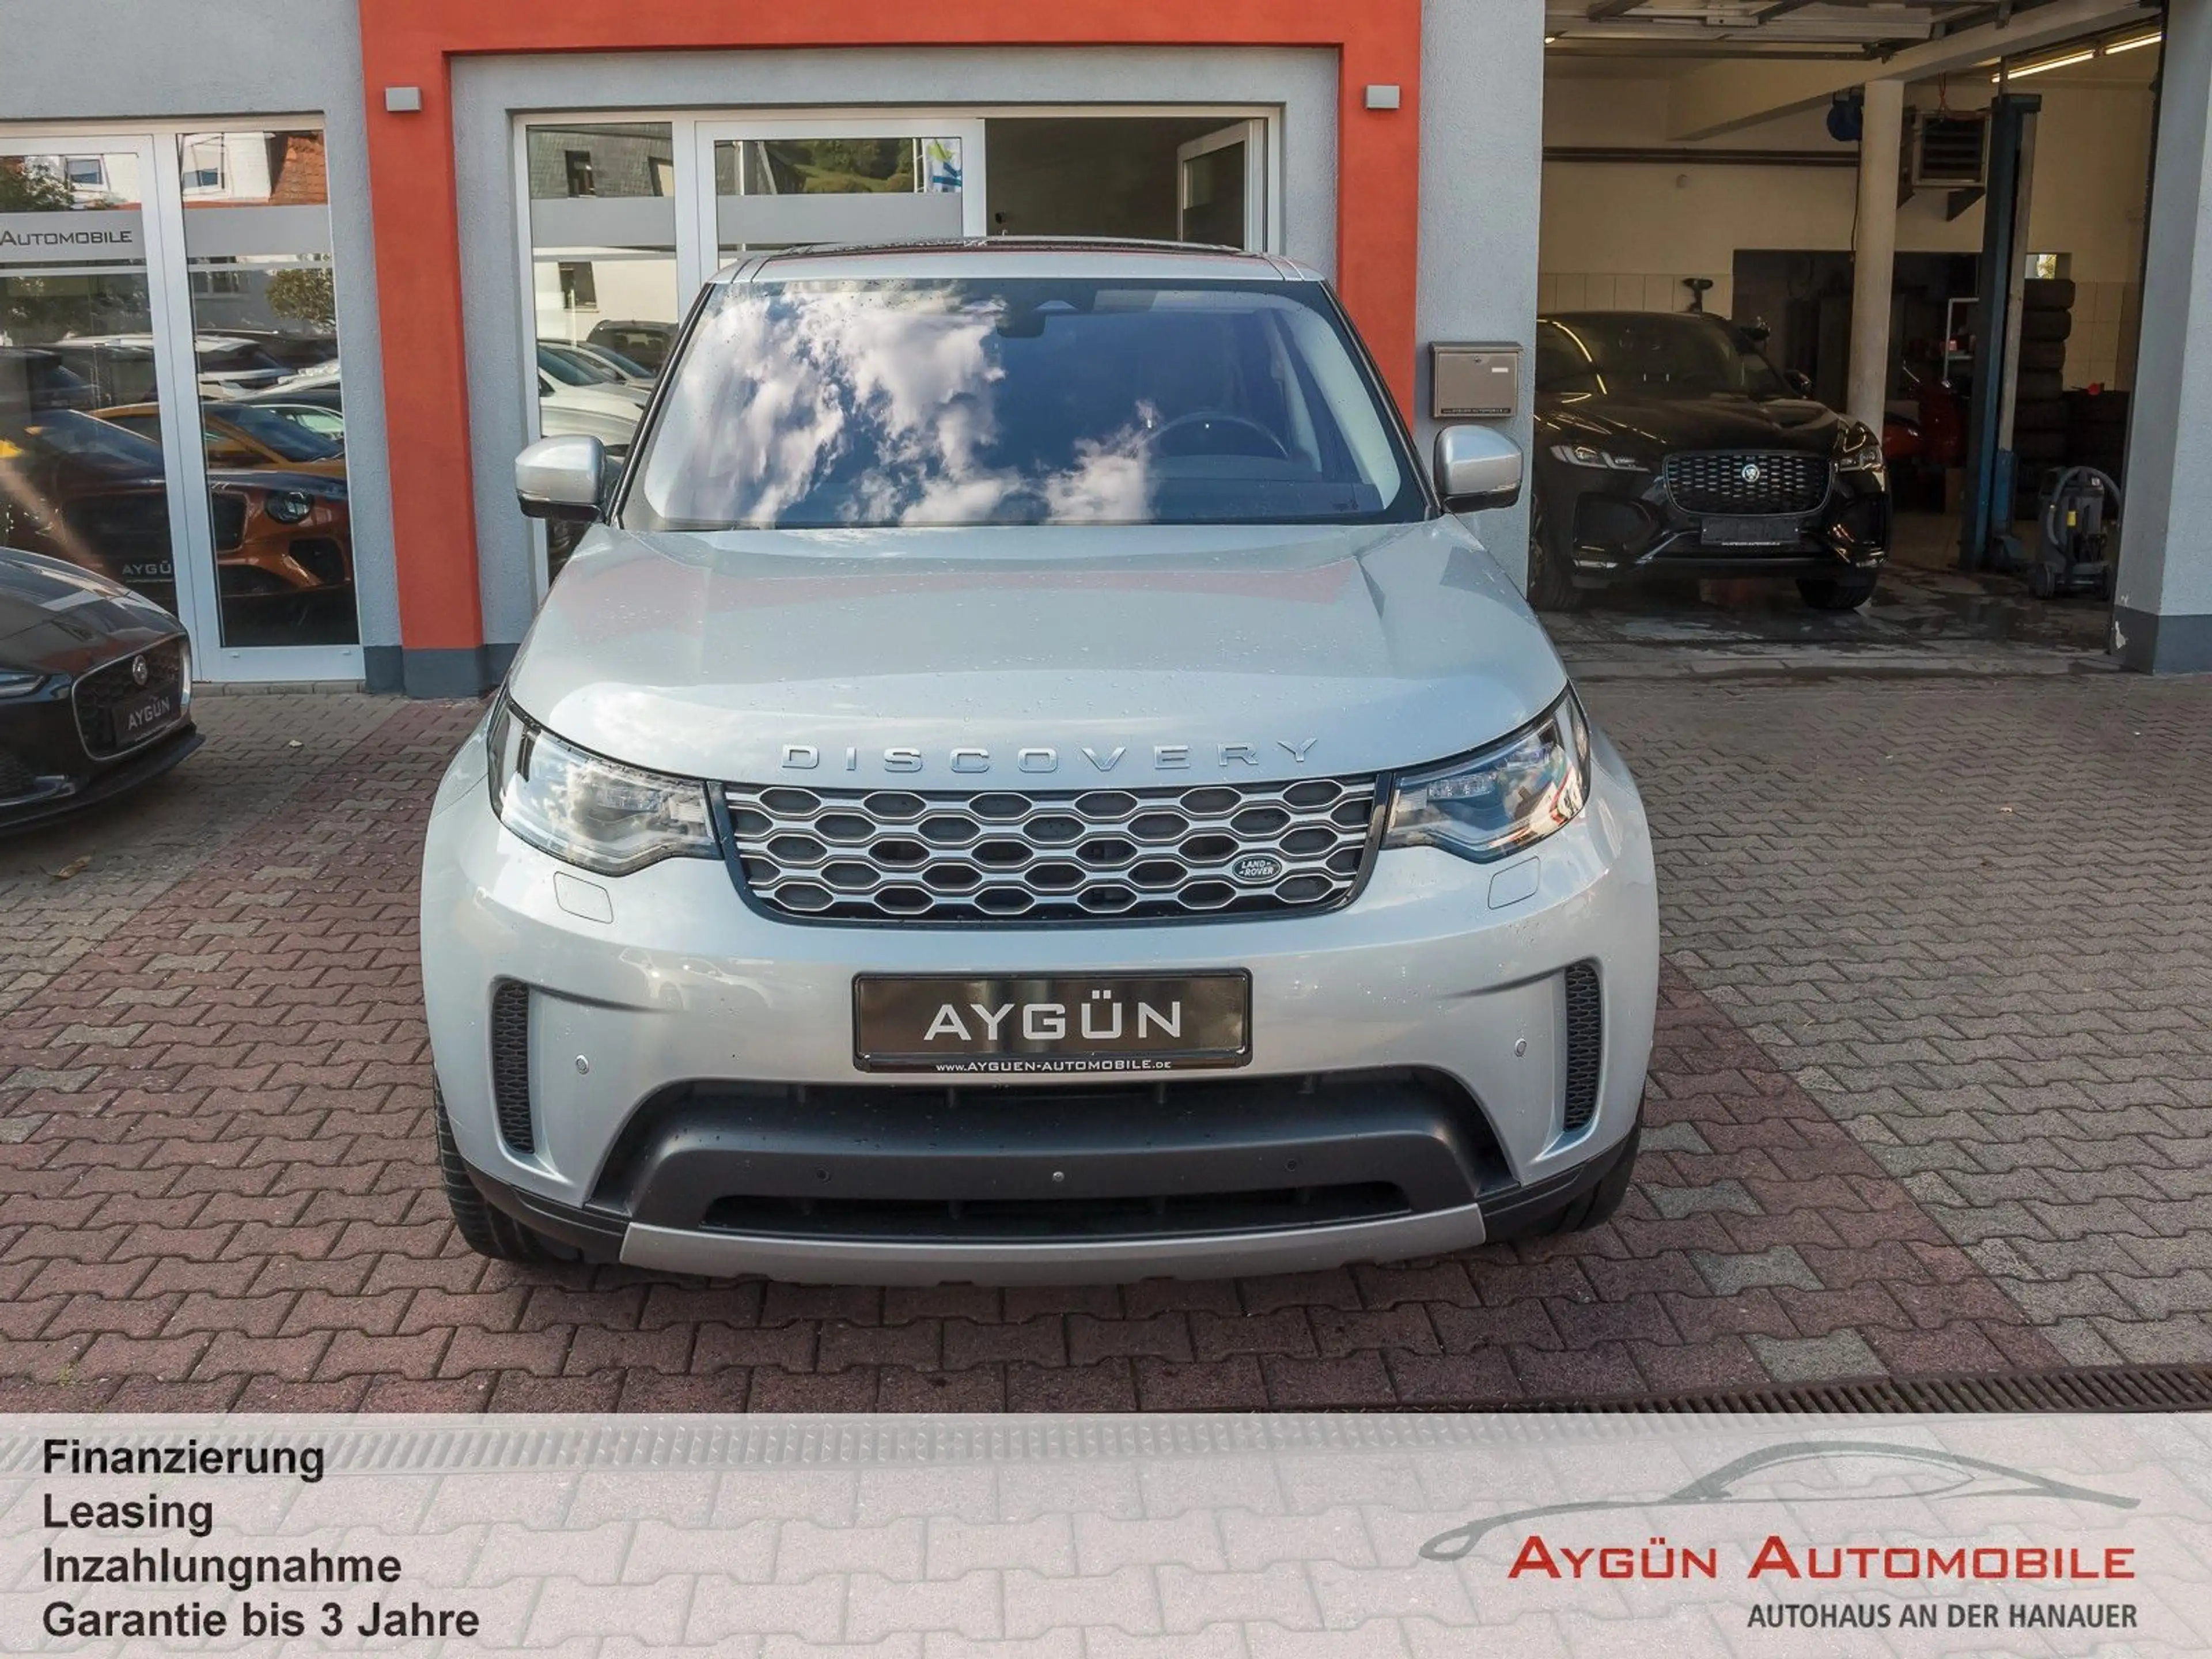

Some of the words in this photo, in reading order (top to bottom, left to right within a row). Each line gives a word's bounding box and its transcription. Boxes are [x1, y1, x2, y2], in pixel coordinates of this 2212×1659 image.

[0, 230, 132, 246] AUTOMOBILE
[122, 560, 172, 574] AYGÜ
[782, 737, 1317, 773] DISCOVERY
[1241, 860, 1266, 869] LAND
[1244, 866, 1274, 876] ROVER
[923, 989, 1181, 1041] AYGÜN
